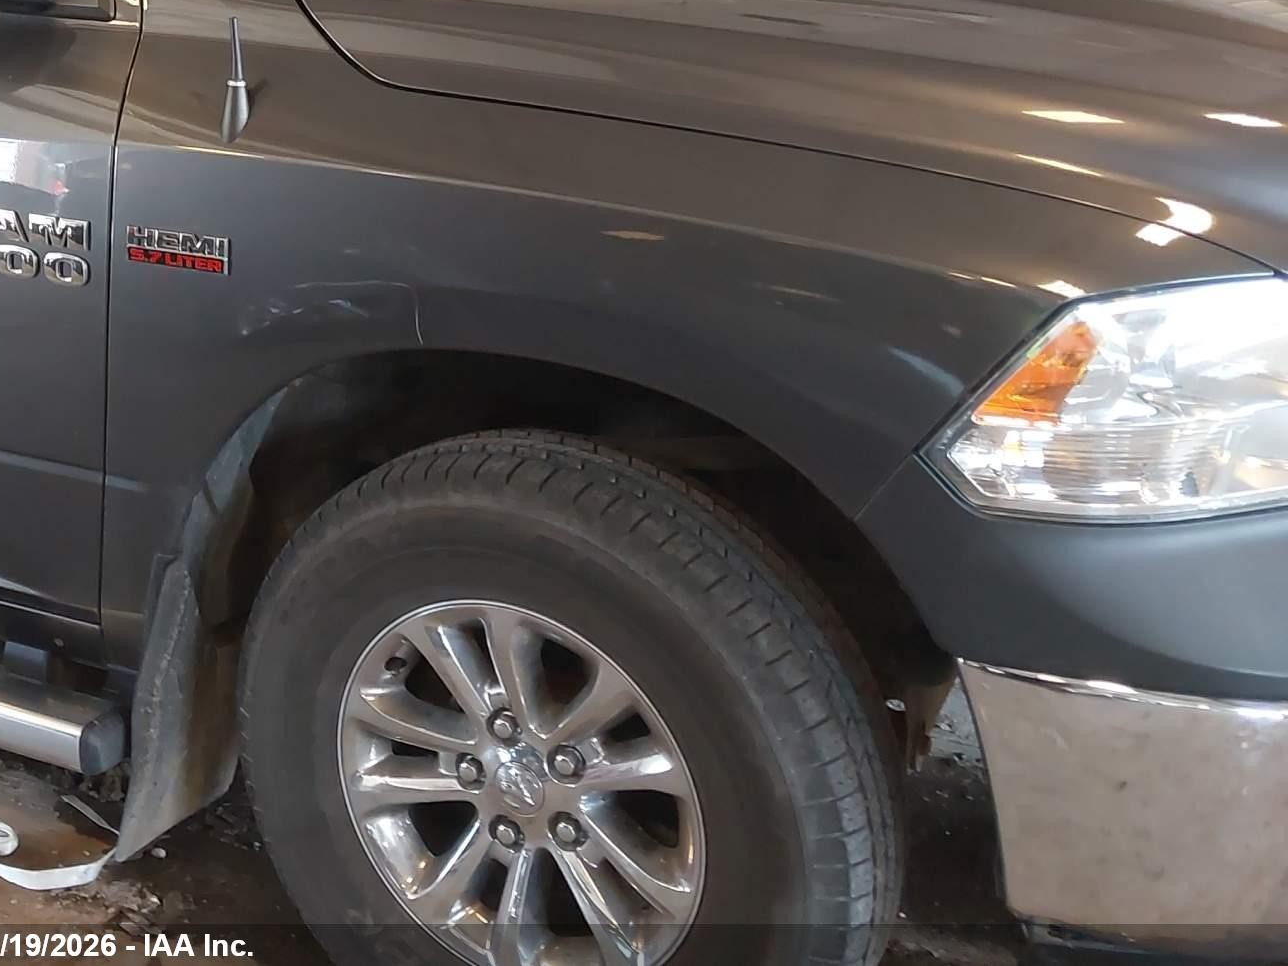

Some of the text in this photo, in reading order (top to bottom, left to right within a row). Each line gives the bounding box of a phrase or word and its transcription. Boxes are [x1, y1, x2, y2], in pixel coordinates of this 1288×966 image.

[127, 225, 229, 258] HEMI
[128, 246, 224, 274] 5.7 LITER
